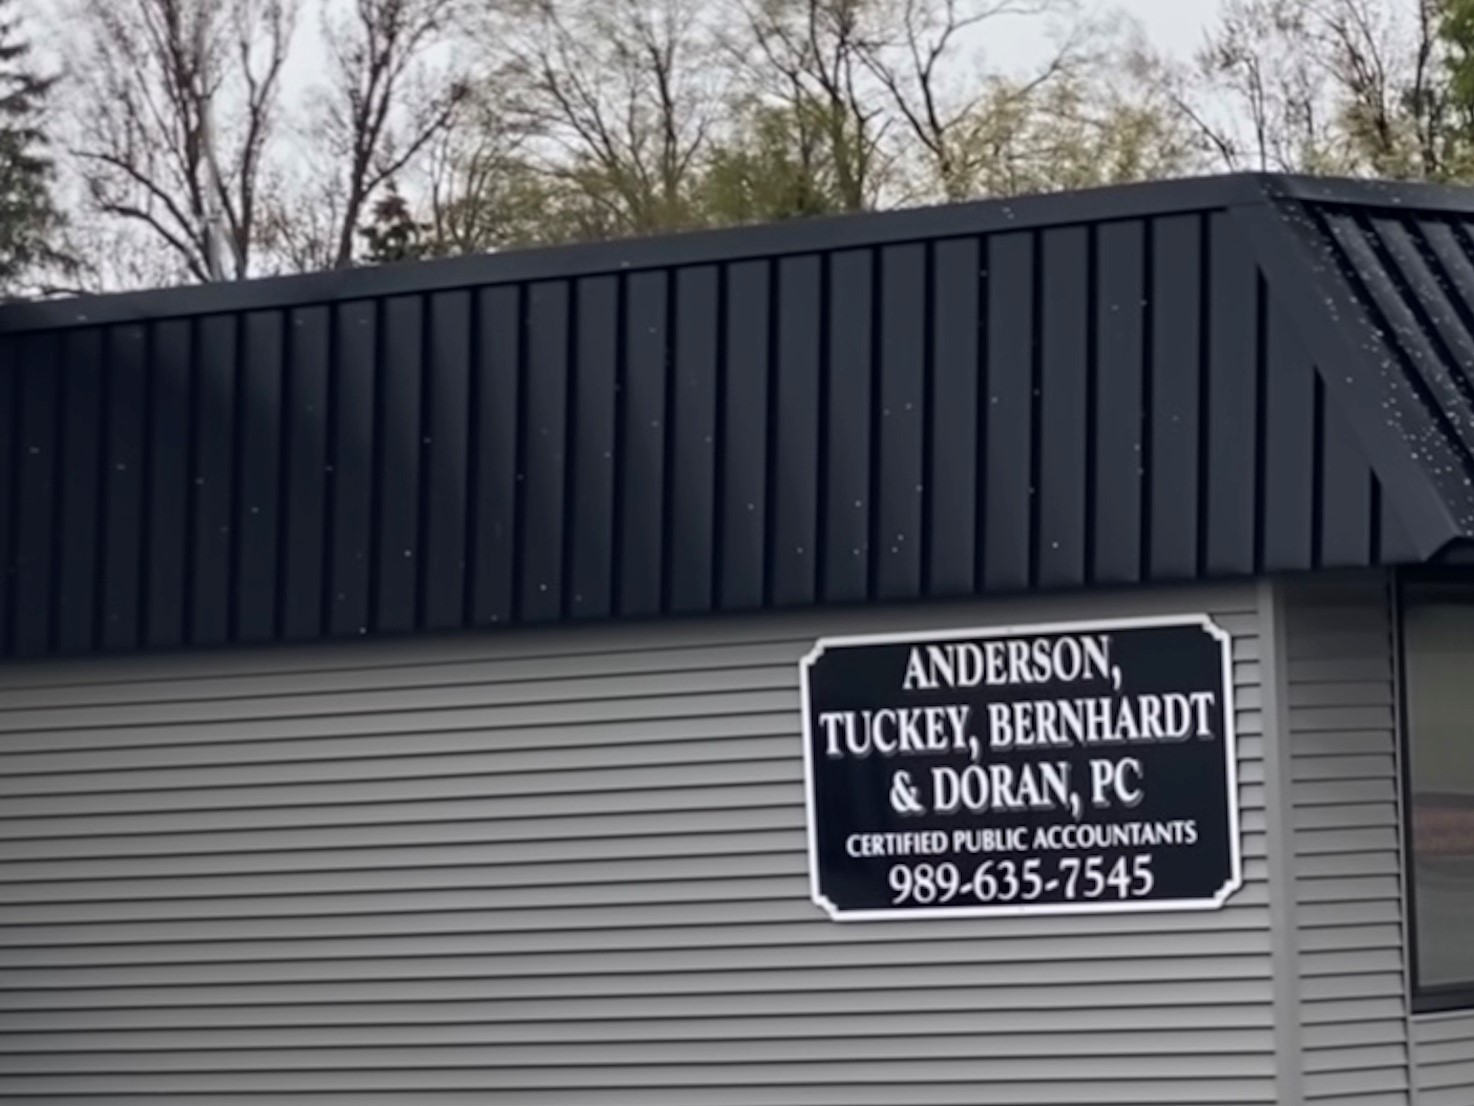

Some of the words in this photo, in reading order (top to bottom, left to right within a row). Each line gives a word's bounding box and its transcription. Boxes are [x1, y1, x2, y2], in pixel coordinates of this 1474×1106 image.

[903, 635, 1122, 690] ANDERSON,
[819, 705, 980, 760] TUCKEY,
[988, 692, 1215, 748] BERNHARDT
[889, 770, 923, 814] &
[932, 761, 1082, 819] DORAN,
[1090, 757, 1143, 806] PC
[846, 829, 948, 858] CERTIFIED
[953, 826, 1029, 854] PUBLIC
[1032, 819, 1198, 851] ACCOUNTANTS
[888, 854, 1154, 905] 989-635-7545
